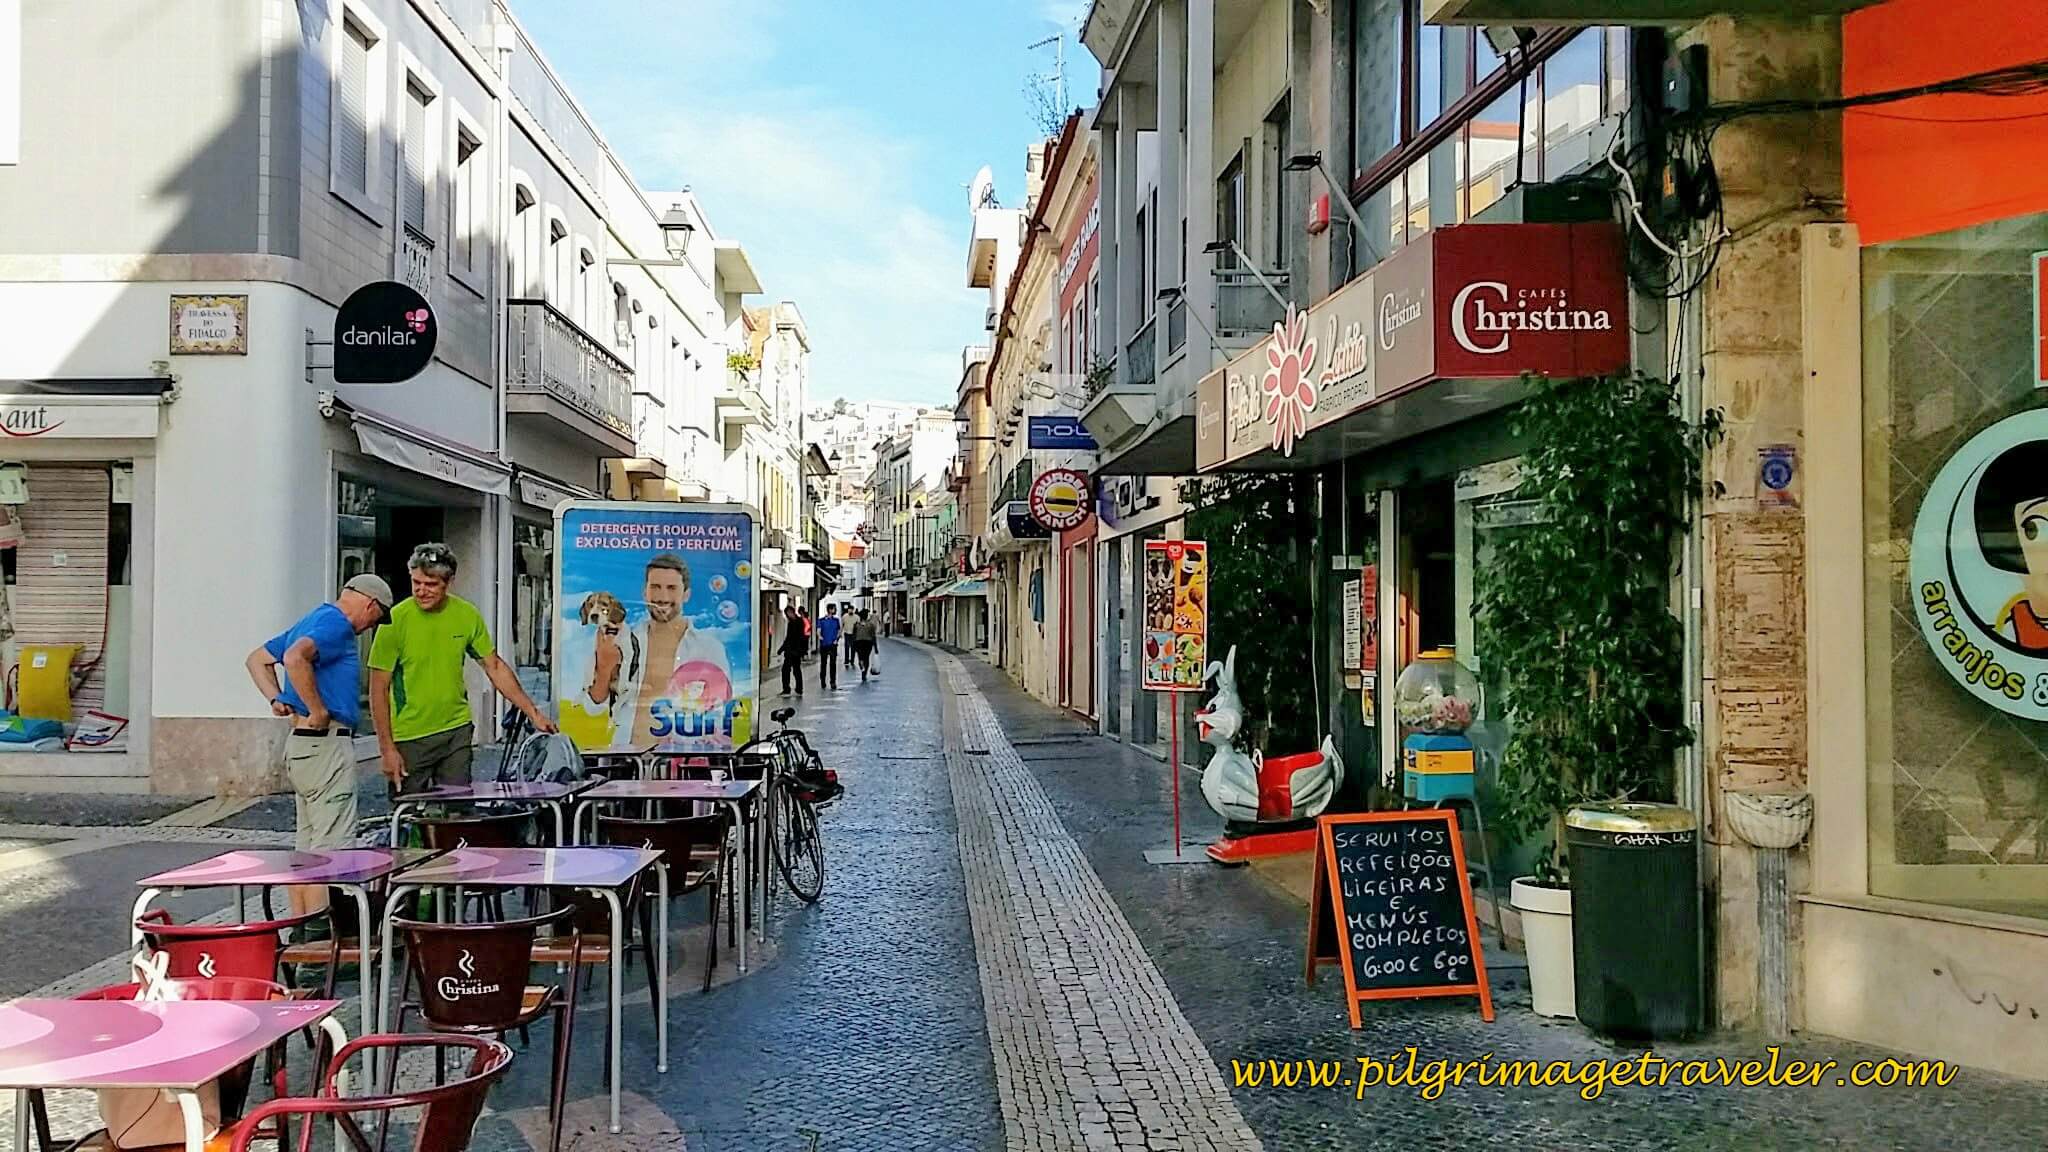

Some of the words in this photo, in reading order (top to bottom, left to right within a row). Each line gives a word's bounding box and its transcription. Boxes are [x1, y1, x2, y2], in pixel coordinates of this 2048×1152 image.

[1518, 287, 1566, 298] CAFÉS
[1379, 292, 1421, 350] Christina
[1451, 281, 1612, 354] Christina
[188, 329, 228, 339] FIDALGO
[1035, 472, 1088, 500] BURGER
[1034, 503, 1087, 528] RANCH
[581, 523, 660, 535] DETERGENTE
[663, 524, 705, 536] ROUPA
[708, 526, 738, 537] COM
[576, 535, 651, 549] EXPLOSÃO
[655, 538, 674, 550] DE
[677, 539, 742, 551] PERFUME
[1921, 580, 2026, 700] arranjos
[649, 699, 742, 738] Surf
[1344, 876, 1447, 897] LIGEIRAS
[1352, 926, 1466, 950] COMPLETOS
[438, 976, 500, 1001] Christina
